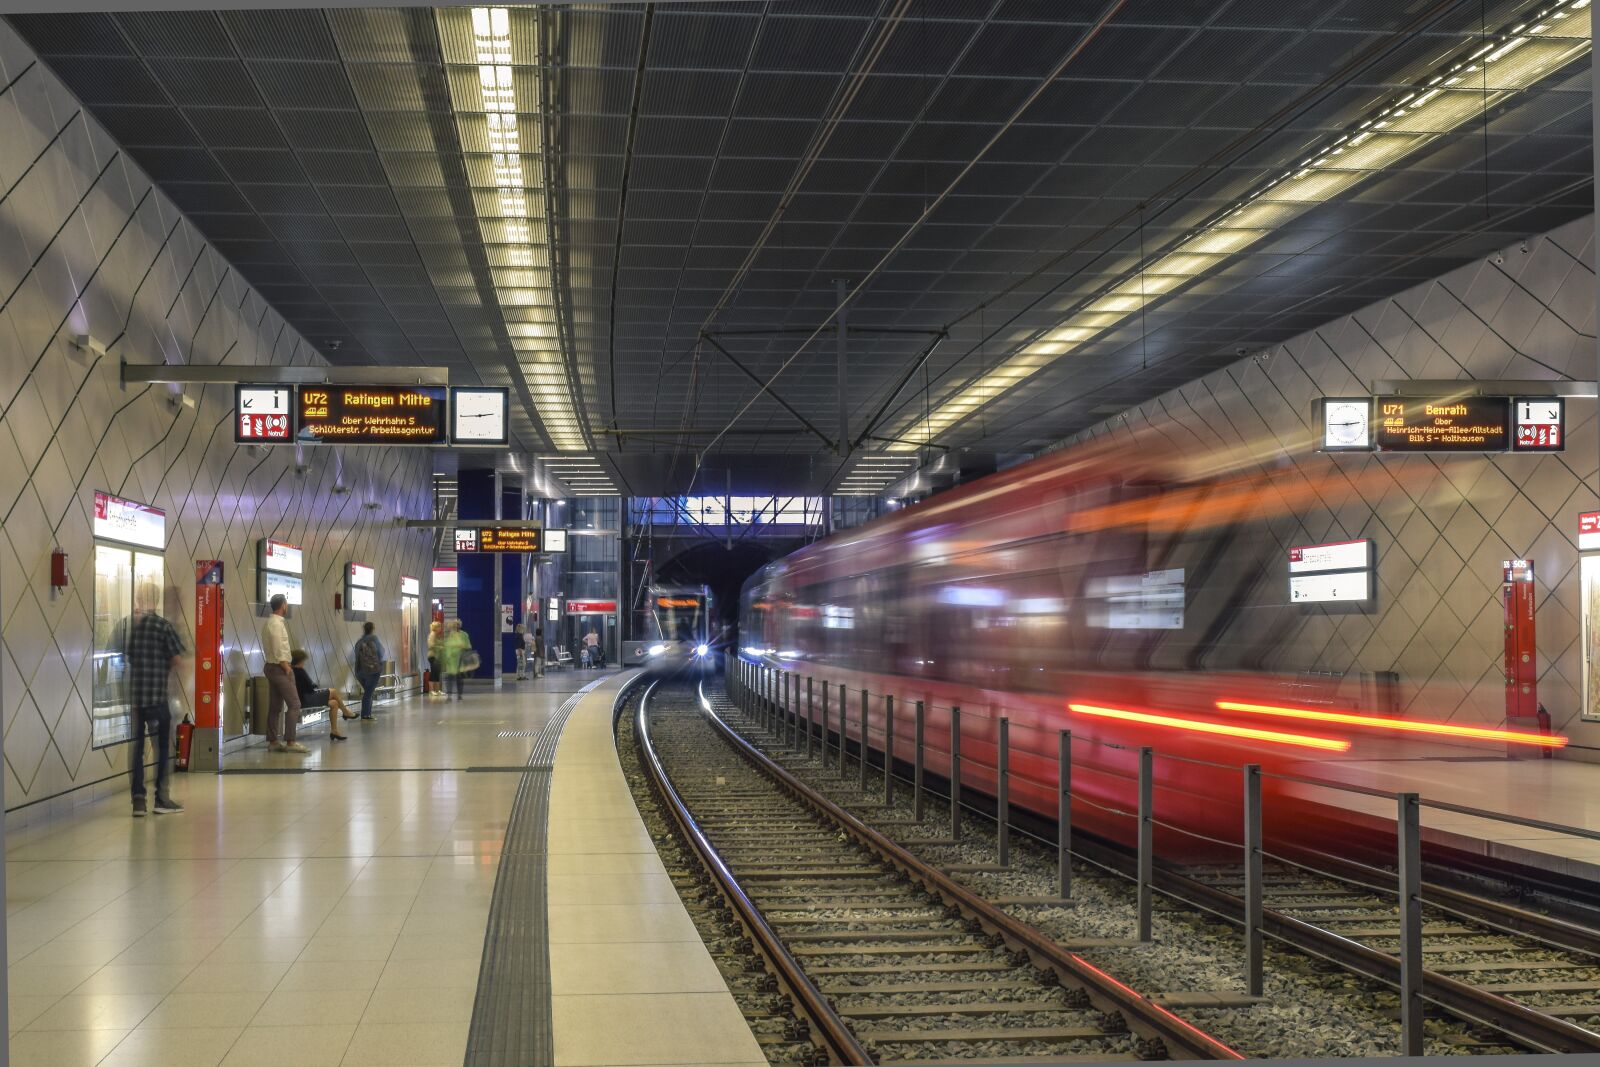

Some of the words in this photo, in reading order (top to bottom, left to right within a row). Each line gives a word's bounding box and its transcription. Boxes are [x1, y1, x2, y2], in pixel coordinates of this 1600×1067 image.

[304, 393, 328, 405] U72
[344, 393, 394, 408] Ratingen
[399, 393, 431, 405] Mitte
[1383, 404, 1404, 415] U71
[1426, 404, 1467, 415] Benrath
[364, 416, 406, 425] Wehrhahn
[408, 417, 415, 425] S
[308, 425, 360, 434] Schlüterstr.
[370, 426, 435, 436] Arbeitsagentur
[1387, 426, 1503, 434] Heinrich-Heine-Allee/Altstadt
[1409, 434, 1424, 442] Bilk
[1442, 434, 1485, 442] Holthausen
[1512, 560, 1527, 568] SOS
